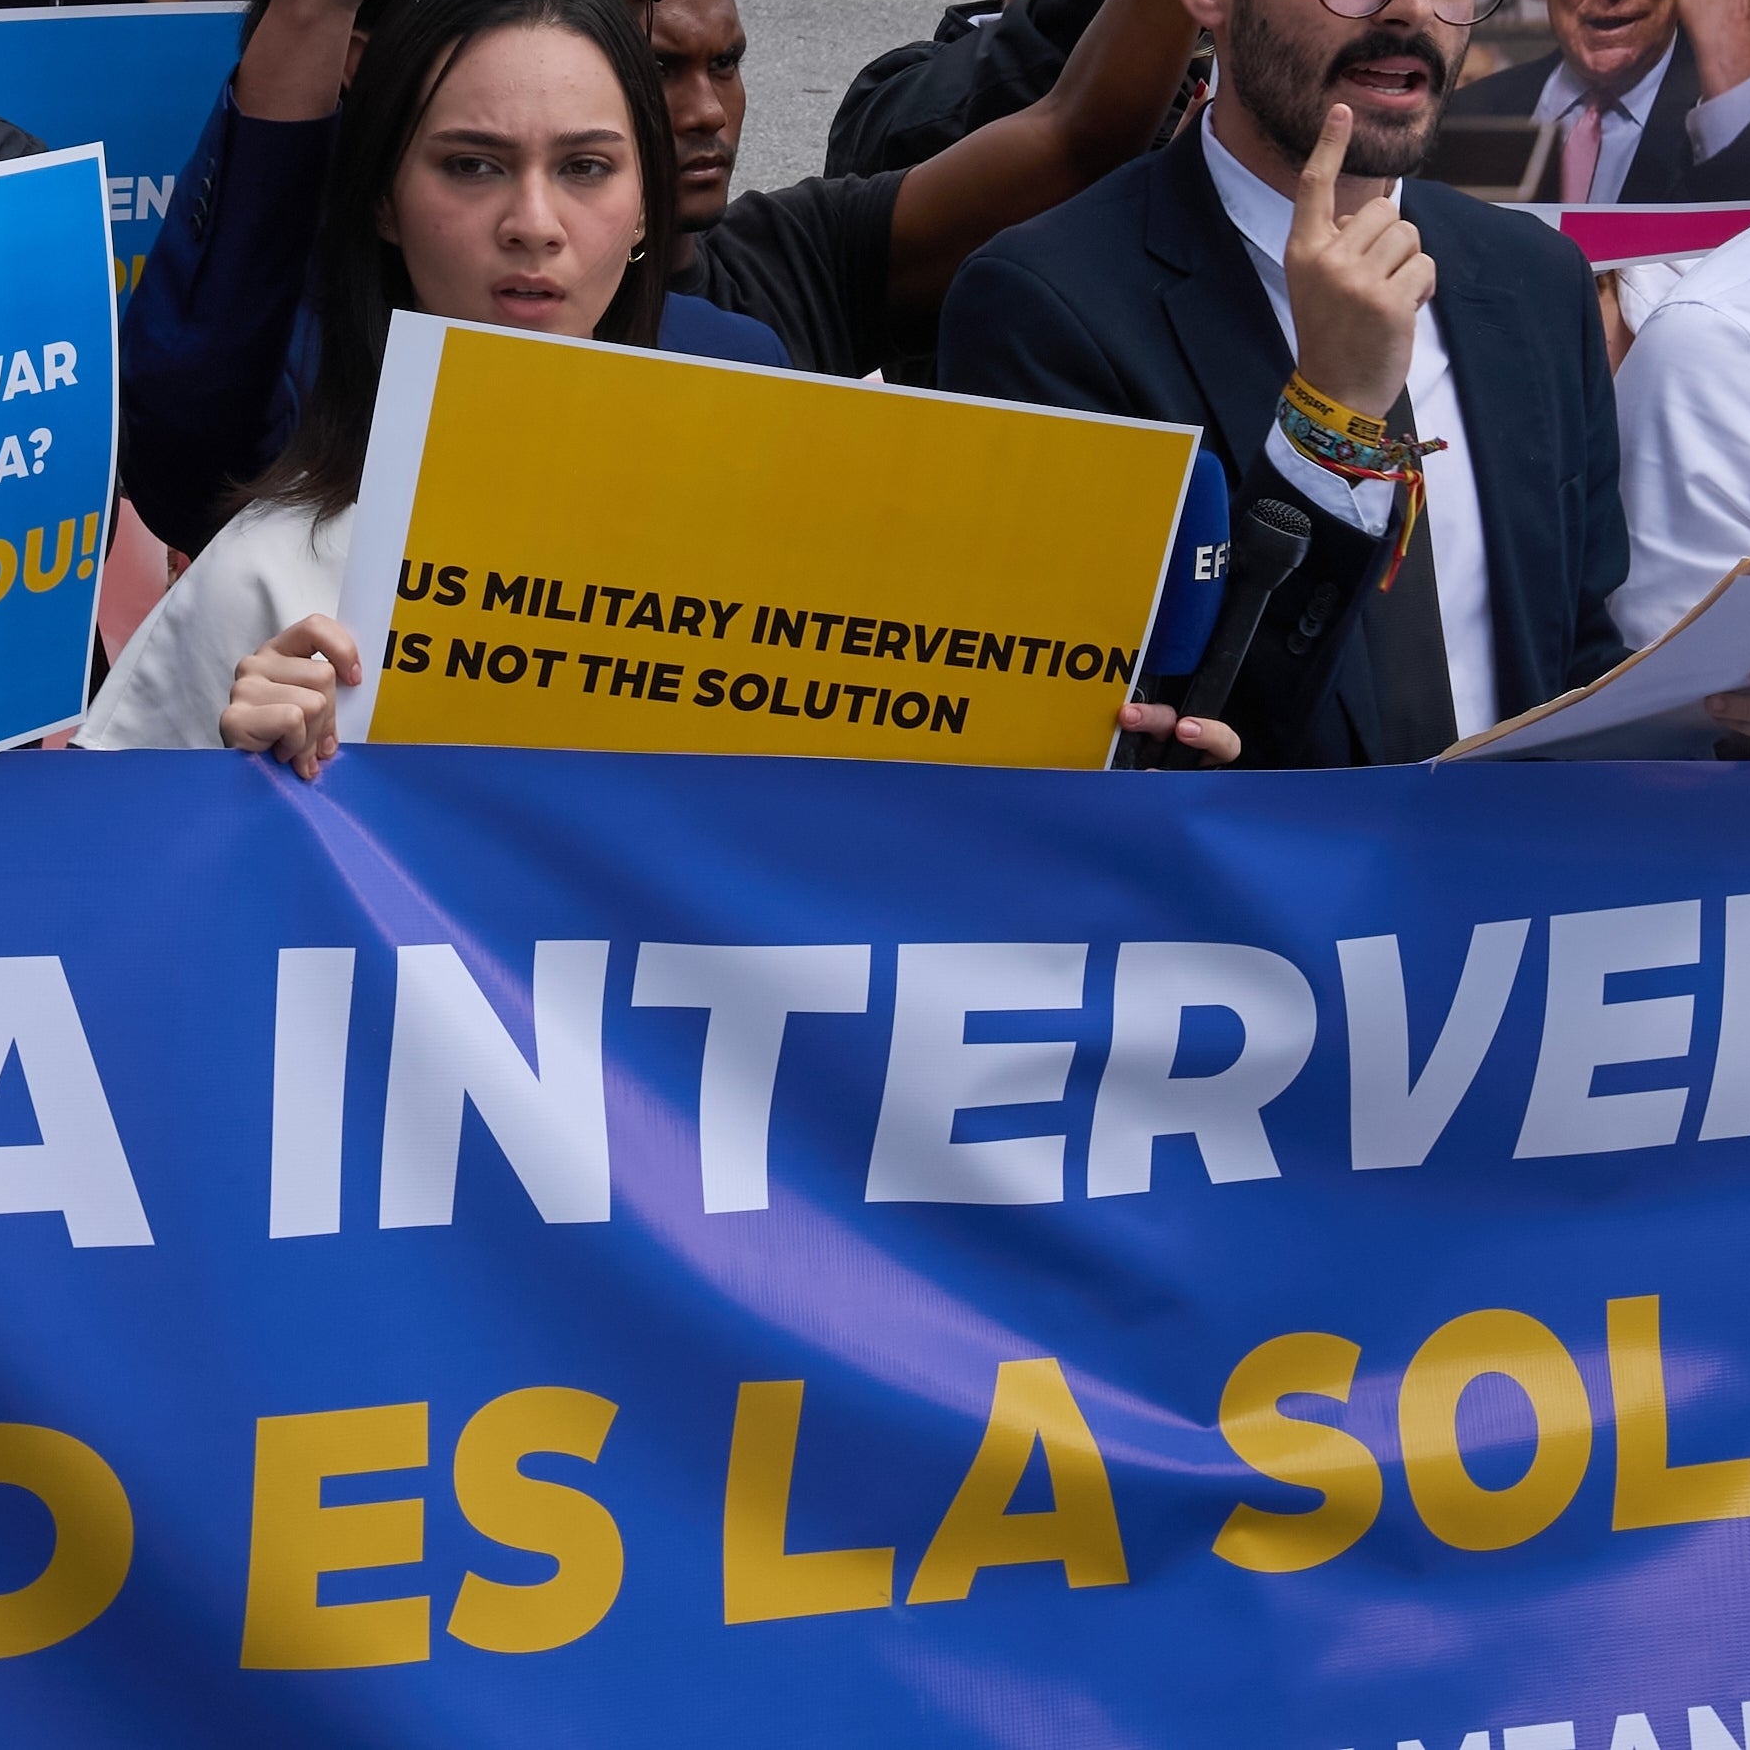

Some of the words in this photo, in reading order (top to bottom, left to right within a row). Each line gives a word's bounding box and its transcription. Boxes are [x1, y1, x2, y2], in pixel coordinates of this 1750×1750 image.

[1195, 540, 1230, 580] EF
[396, 559, 468, 608] US
[480, 573, 744, 641] MILITARY
[750, 605, 1139, 685] INTERVENTION
[383, 630, 431, 674] IS
[446, 639, 568, 688] NOT
[579, 654, 683, 702] THE
[694, 672, 970, 735] SOLUTION
[239, 1386, 625, 1671] ES
[723, 1357, 1130, 1625] LA
